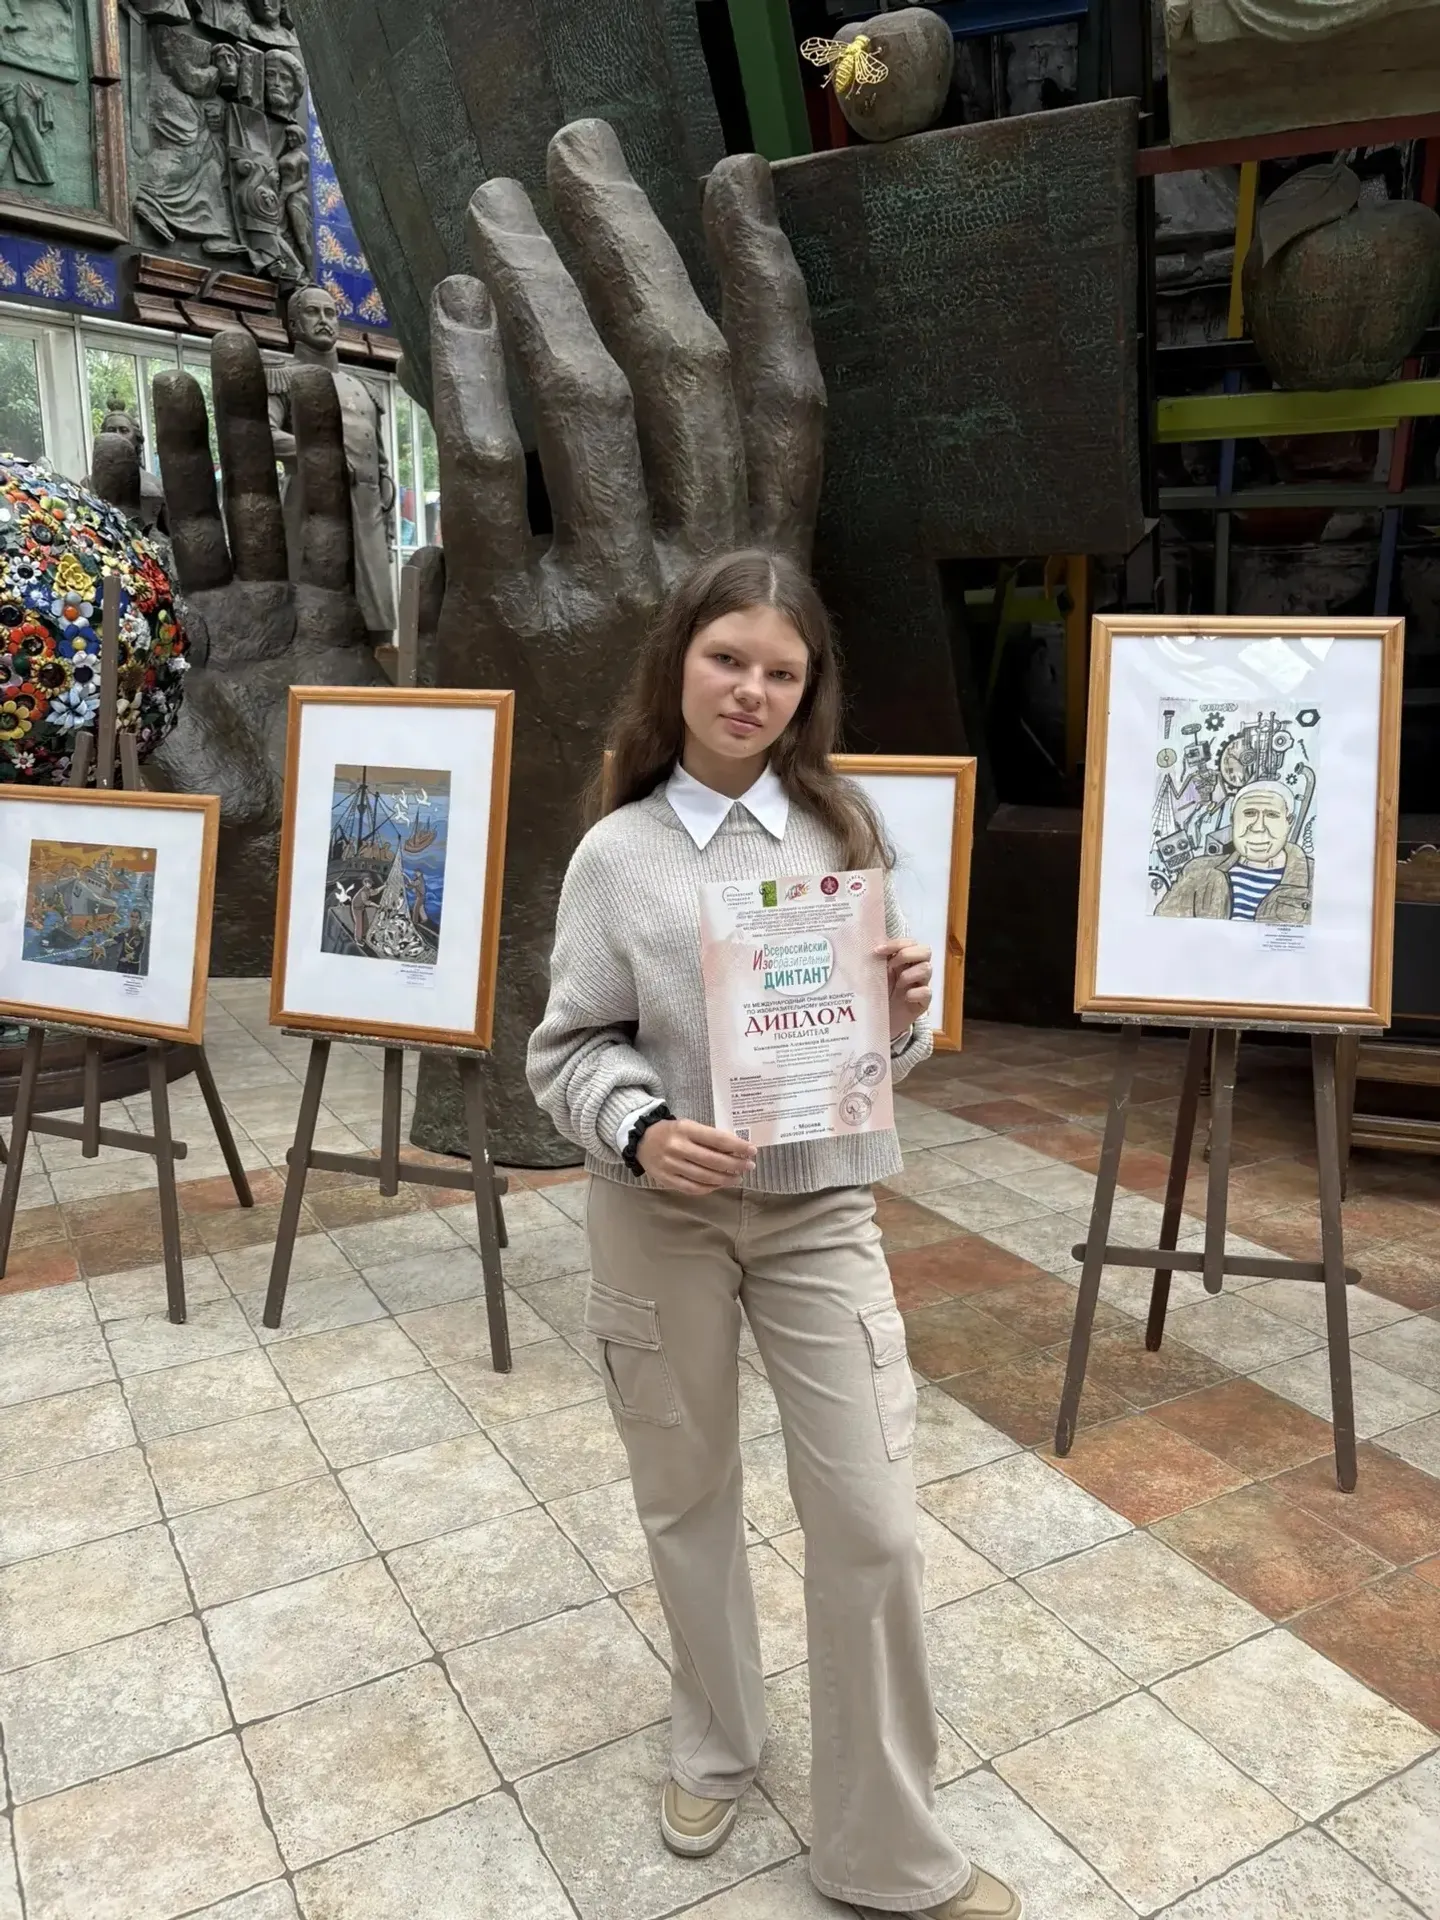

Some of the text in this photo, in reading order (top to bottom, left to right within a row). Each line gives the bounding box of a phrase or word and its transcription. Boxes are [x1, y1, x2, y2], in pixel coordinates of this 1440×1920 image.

[763, 940, 828, 957] Всероссийский
[753, 950, 831, 971] Изобразительный
[764, 966, 830, 990] ДИКТАНТ
[752, 996, 806, 1008] МЕЖДУНАРОДНЫЙ
[829, 992, 855, 1000] КОНКУРС
[757, 1003, 818, 1014] ИЗОБРАЗИТЕЛЬНОМУ
[819, 999, 853, 1007] ИСКУССТВУ
[744, 1006, 857, 1037] ДИПЛОМ
[774, 1027, 830, 1040] ПОБЕДИТЕЛЯ
